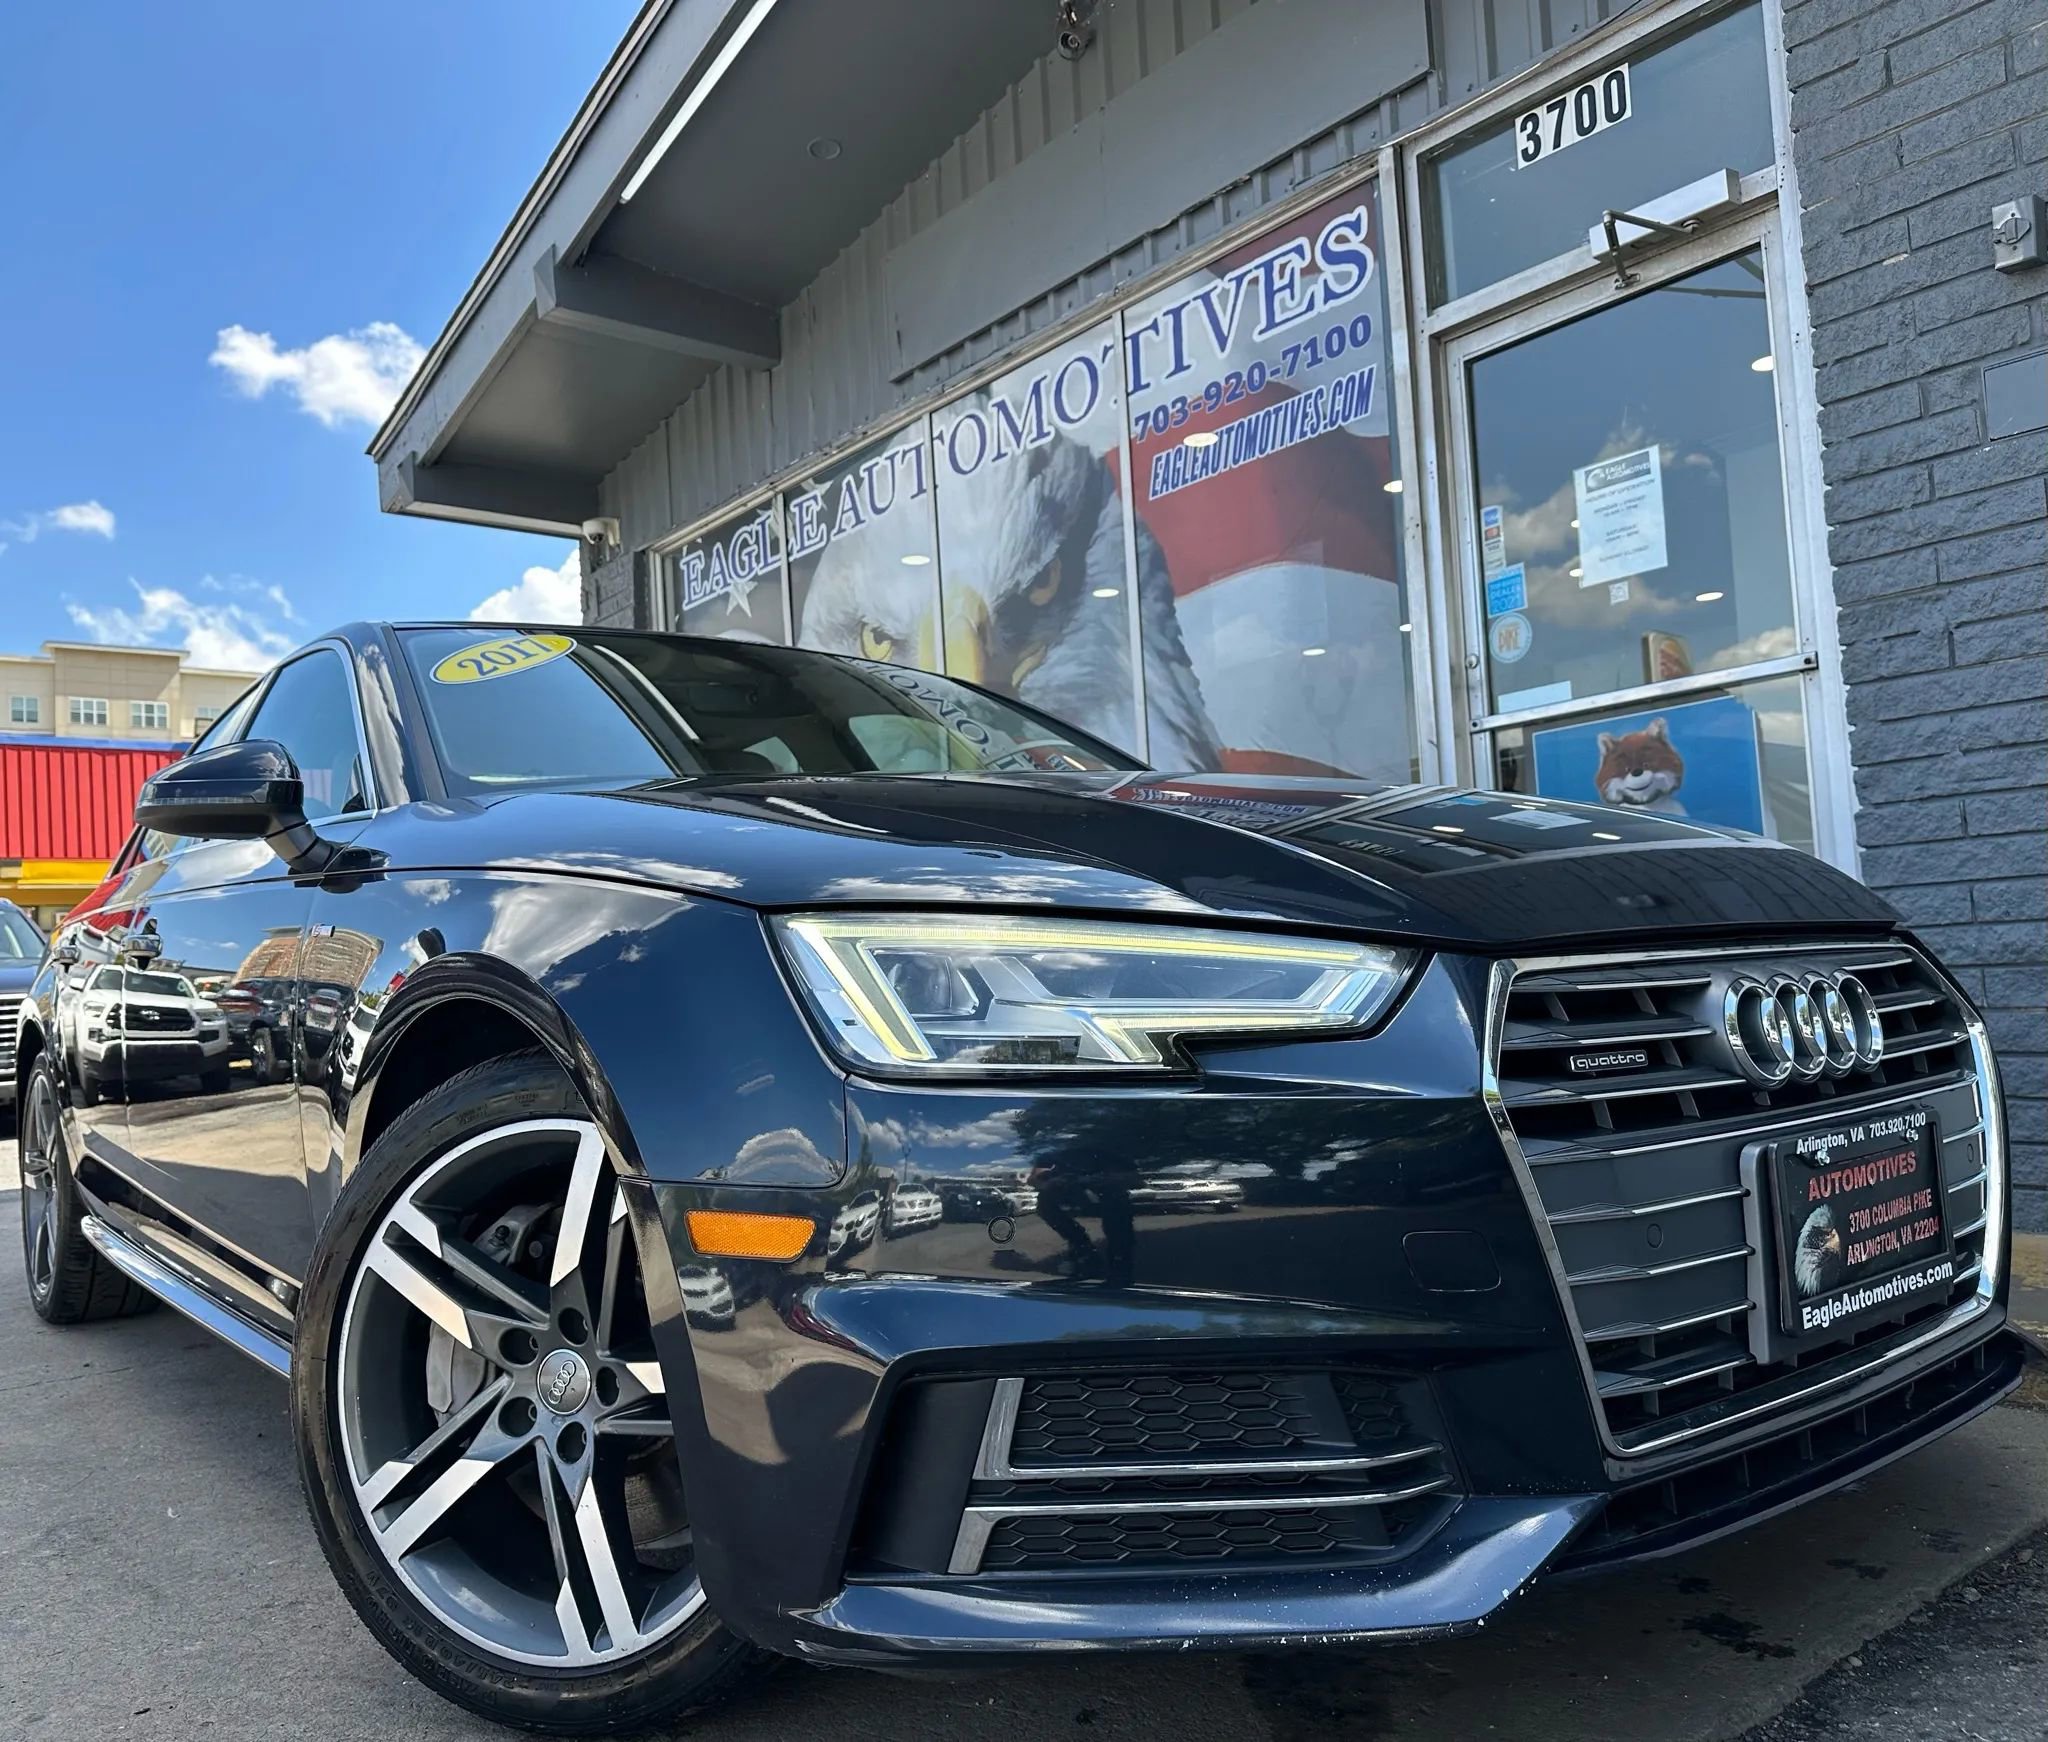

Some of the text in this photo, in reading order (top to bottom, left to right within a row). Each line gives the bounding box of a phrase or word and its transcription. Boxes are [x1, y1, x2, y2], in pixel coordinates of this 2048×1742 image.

[1518, 69, 1629, 164] 3700
[1134, 314, 1372, 442] 703-920-7100
[681, 205, 1374, 611] EAGLE AUTOMOTIVES
[1149, 365, 1377, 500] EAGLEAUTOMOTIVES.COM
[457, 638, 552, 676] 2017
[1576, 1053, 1646, 1069] quattro
[1796, 1112, 1926, 1155] Arlington, VA 703.920.7100
[1808, 1151, 1916, 1201] AUTOMOTIVES
[1849, 1188, 1933, 1234] 3700 COLUMBIA PIKE
[1847, 1216, 1940, 1266] ARLINGTON, VA 22204
[1802, 1261, 1953, 1330] EagleAutomotives.com
